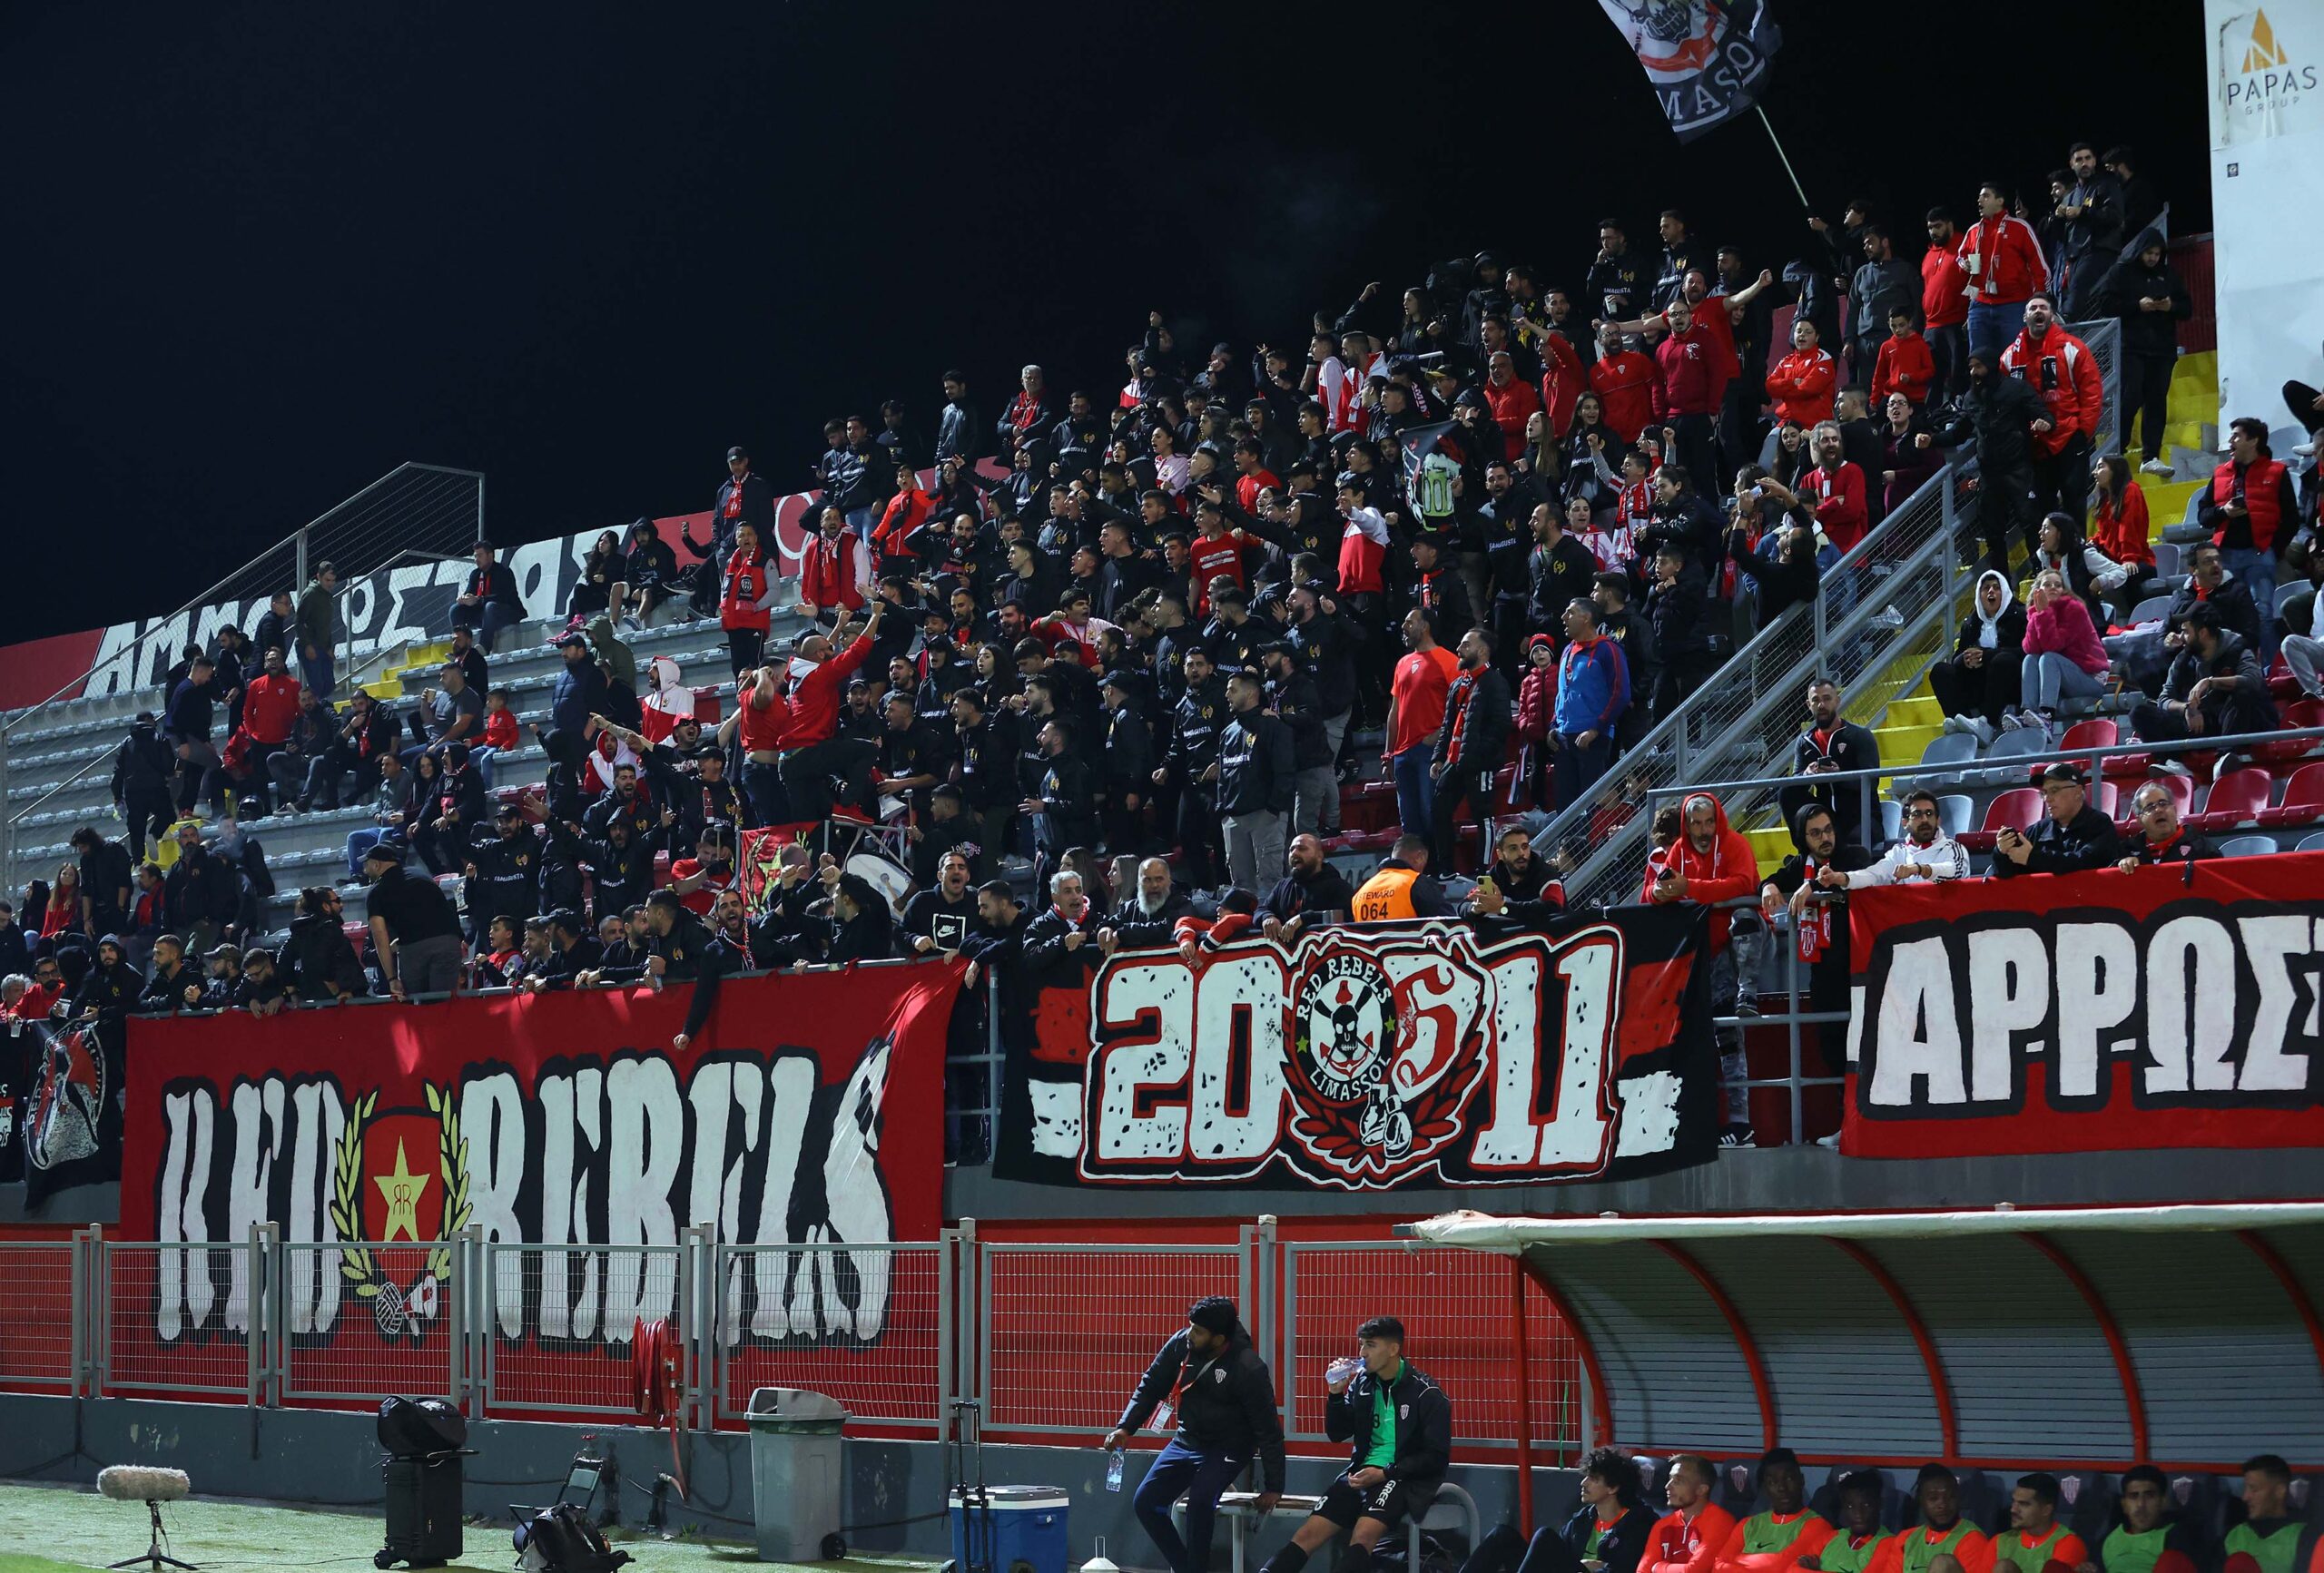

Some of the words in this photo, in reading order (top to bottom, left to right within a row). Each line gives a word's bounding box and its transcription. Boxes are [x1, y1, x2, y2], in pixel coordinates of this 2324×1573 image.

[2227, 65, 2317, 106] PAPAS
[1360, 901, 1389, 921] 064
[1296, 973, 1323, 1021] RED
[1326, 955, 1392, 1004] REBELS
[1309, 1056, 1393, 1102] LIMASSOL
[460, 1046, 892, 1342] REBELS
[1314, 1495, 1329, 1511] 8
[1374, 1480, 1397, 1508] GREE
